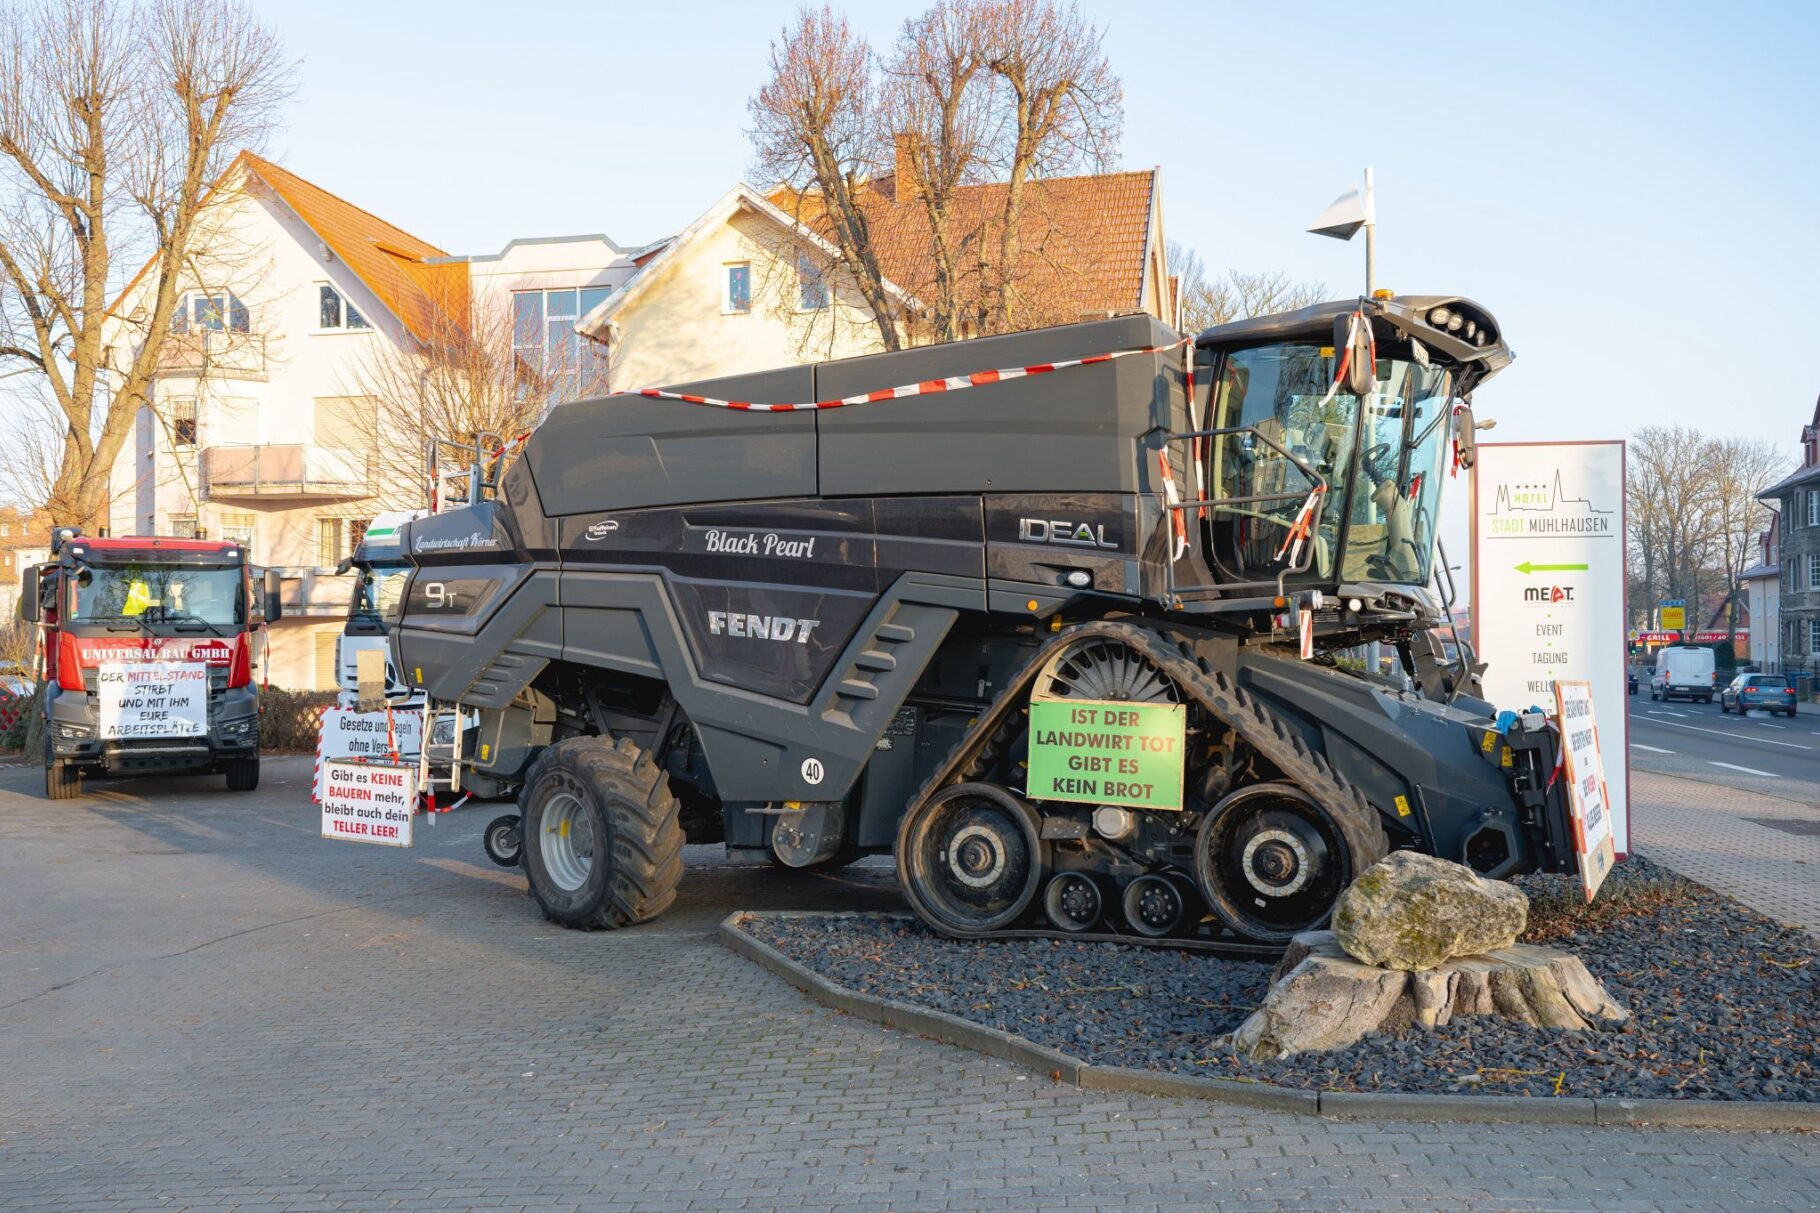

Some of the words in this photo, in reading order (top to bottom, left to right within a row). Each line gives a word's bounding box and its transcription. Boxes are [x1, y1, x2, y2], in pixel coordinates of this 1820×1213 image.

[1514, 493, 1549, 503] HOTEL
[1492, 519, 1525, 533] STADT
[1529, 516, 1608, 532] MÜHLHAUSEN
[415, 535, 469, 552] Landwirtschaft
[470, 532, 498, 547] Körner
[1018, 518, 1118, 549] IDEAL
[705, 529, 758, 554] Black
[763, 533, 815, 558] Pearl
[708, 610, 820, 643] FENDT
[1536, 624, 1563, 636] EVENT
[82, 648, 159, 660] UNIVERSAL
[162, 648, 188, 660] BAU
[191, 648, 230, 660] GMBH
[1532, 652, 1568, 664] TAGUNG
[101, 672, 125, 683] DER
[127, 670, 205, 682] MITTELSTAND
[134, 684, 174, 695] STIRBT
[118, 697, 143, 709] UND
[146, 697, 165, 708] MIT
[169, 697, 189, 708] IHM
[139, 711, 169, 722] EURE
[340, 716, 373, 732] Gesetze
[1071, 709, 1098, 724] IST
[1104, 711, 1140, 727] DER
[349, 738, 369, 753] ohne
[1036, 730, 1133, 750] LANDWIRT
[1139, 736, 1176, 753] TOT
[806, 762, 820, 780] 40
[1068, 756, 1112, 772] GIBT
[1118, 759, 1139, 774] ES
[331, 769, 353, 781] Gibt
[356, 774, 367, 783] es
[371, 772, 403, 786] KEINE
[329, 786, 372, 800] BAUERN
[375, 792, 405, 806] mehr,
[1053, 777, 1097, 795] KEIN
[1104, 781, 1154, 799] BROT
[325, 802, 354, 816] bleibt
[357, 808, 382, 819] auch
[385, 809, 409, 822] dein
[333, 820, 368, 834] TELLER
[371, 825, 399, 839] LEER!
